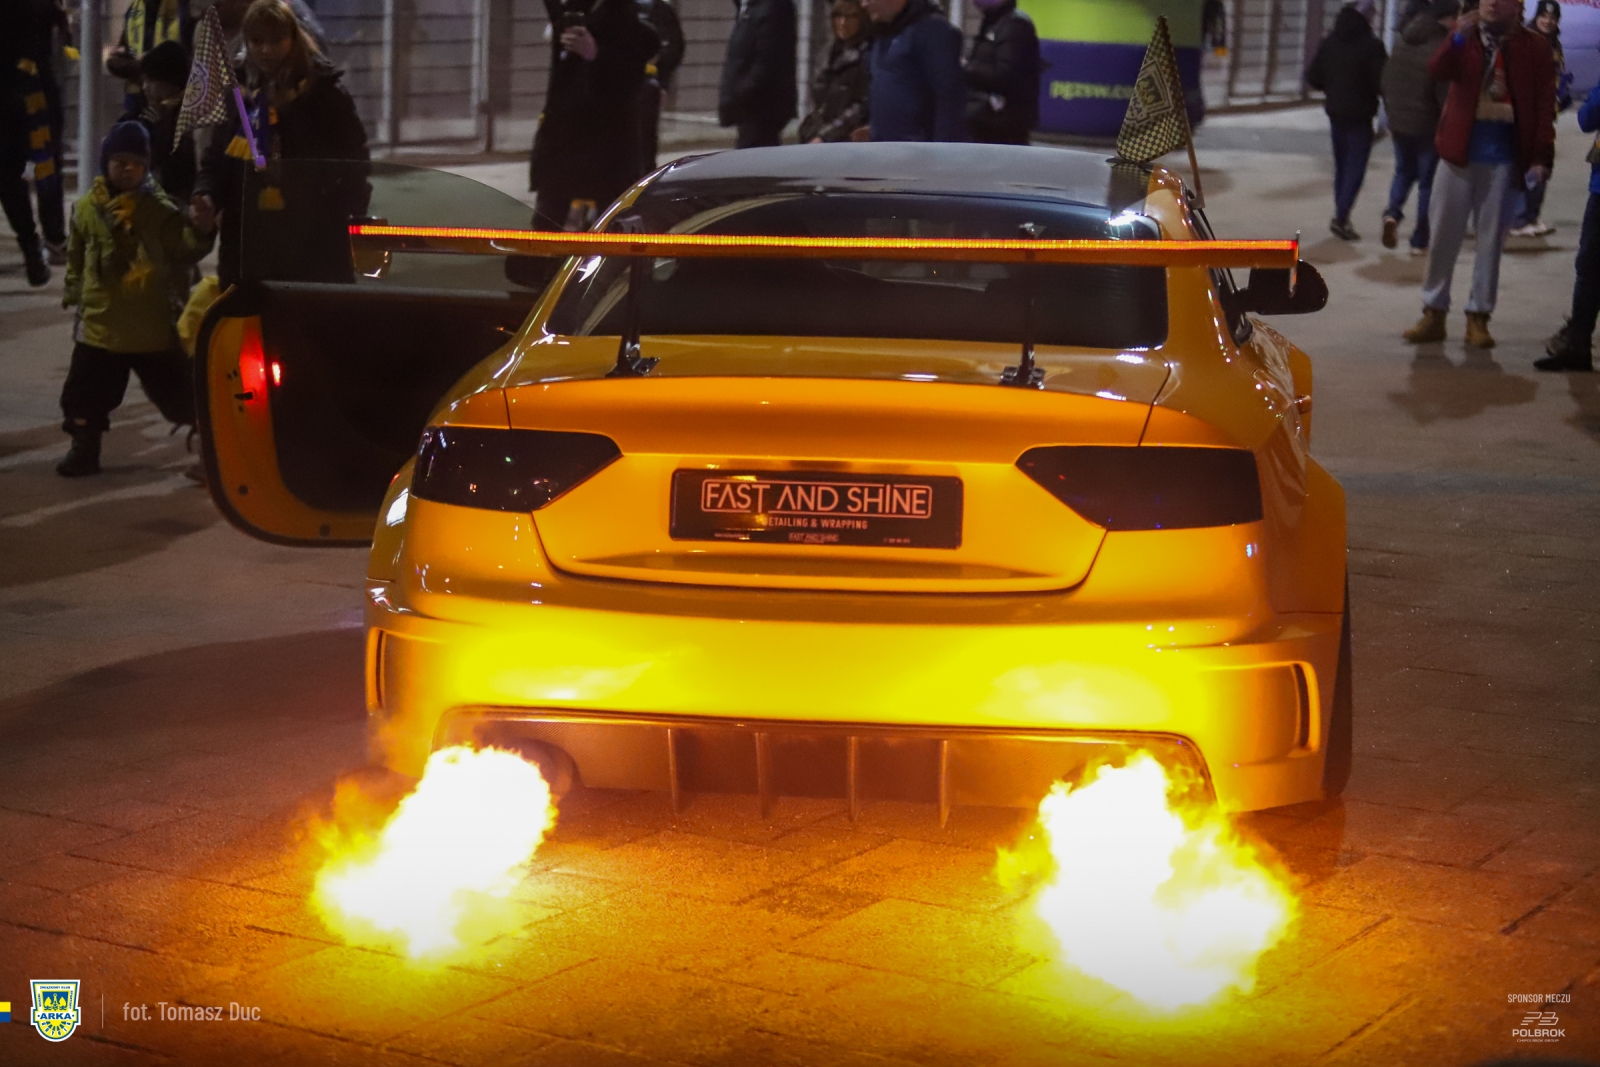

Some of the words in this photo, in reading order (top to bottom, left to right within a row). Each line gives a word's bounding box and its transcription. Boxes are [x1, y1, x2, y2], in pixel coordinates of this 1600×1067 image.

[706, 483, 770, 513] FAST
[776, 485, 839, 511] AND
[847, 484, 927, 514] SHINE
[810, 518, 818, 528] &
[821, 519, 868, 529] WRAPPING
